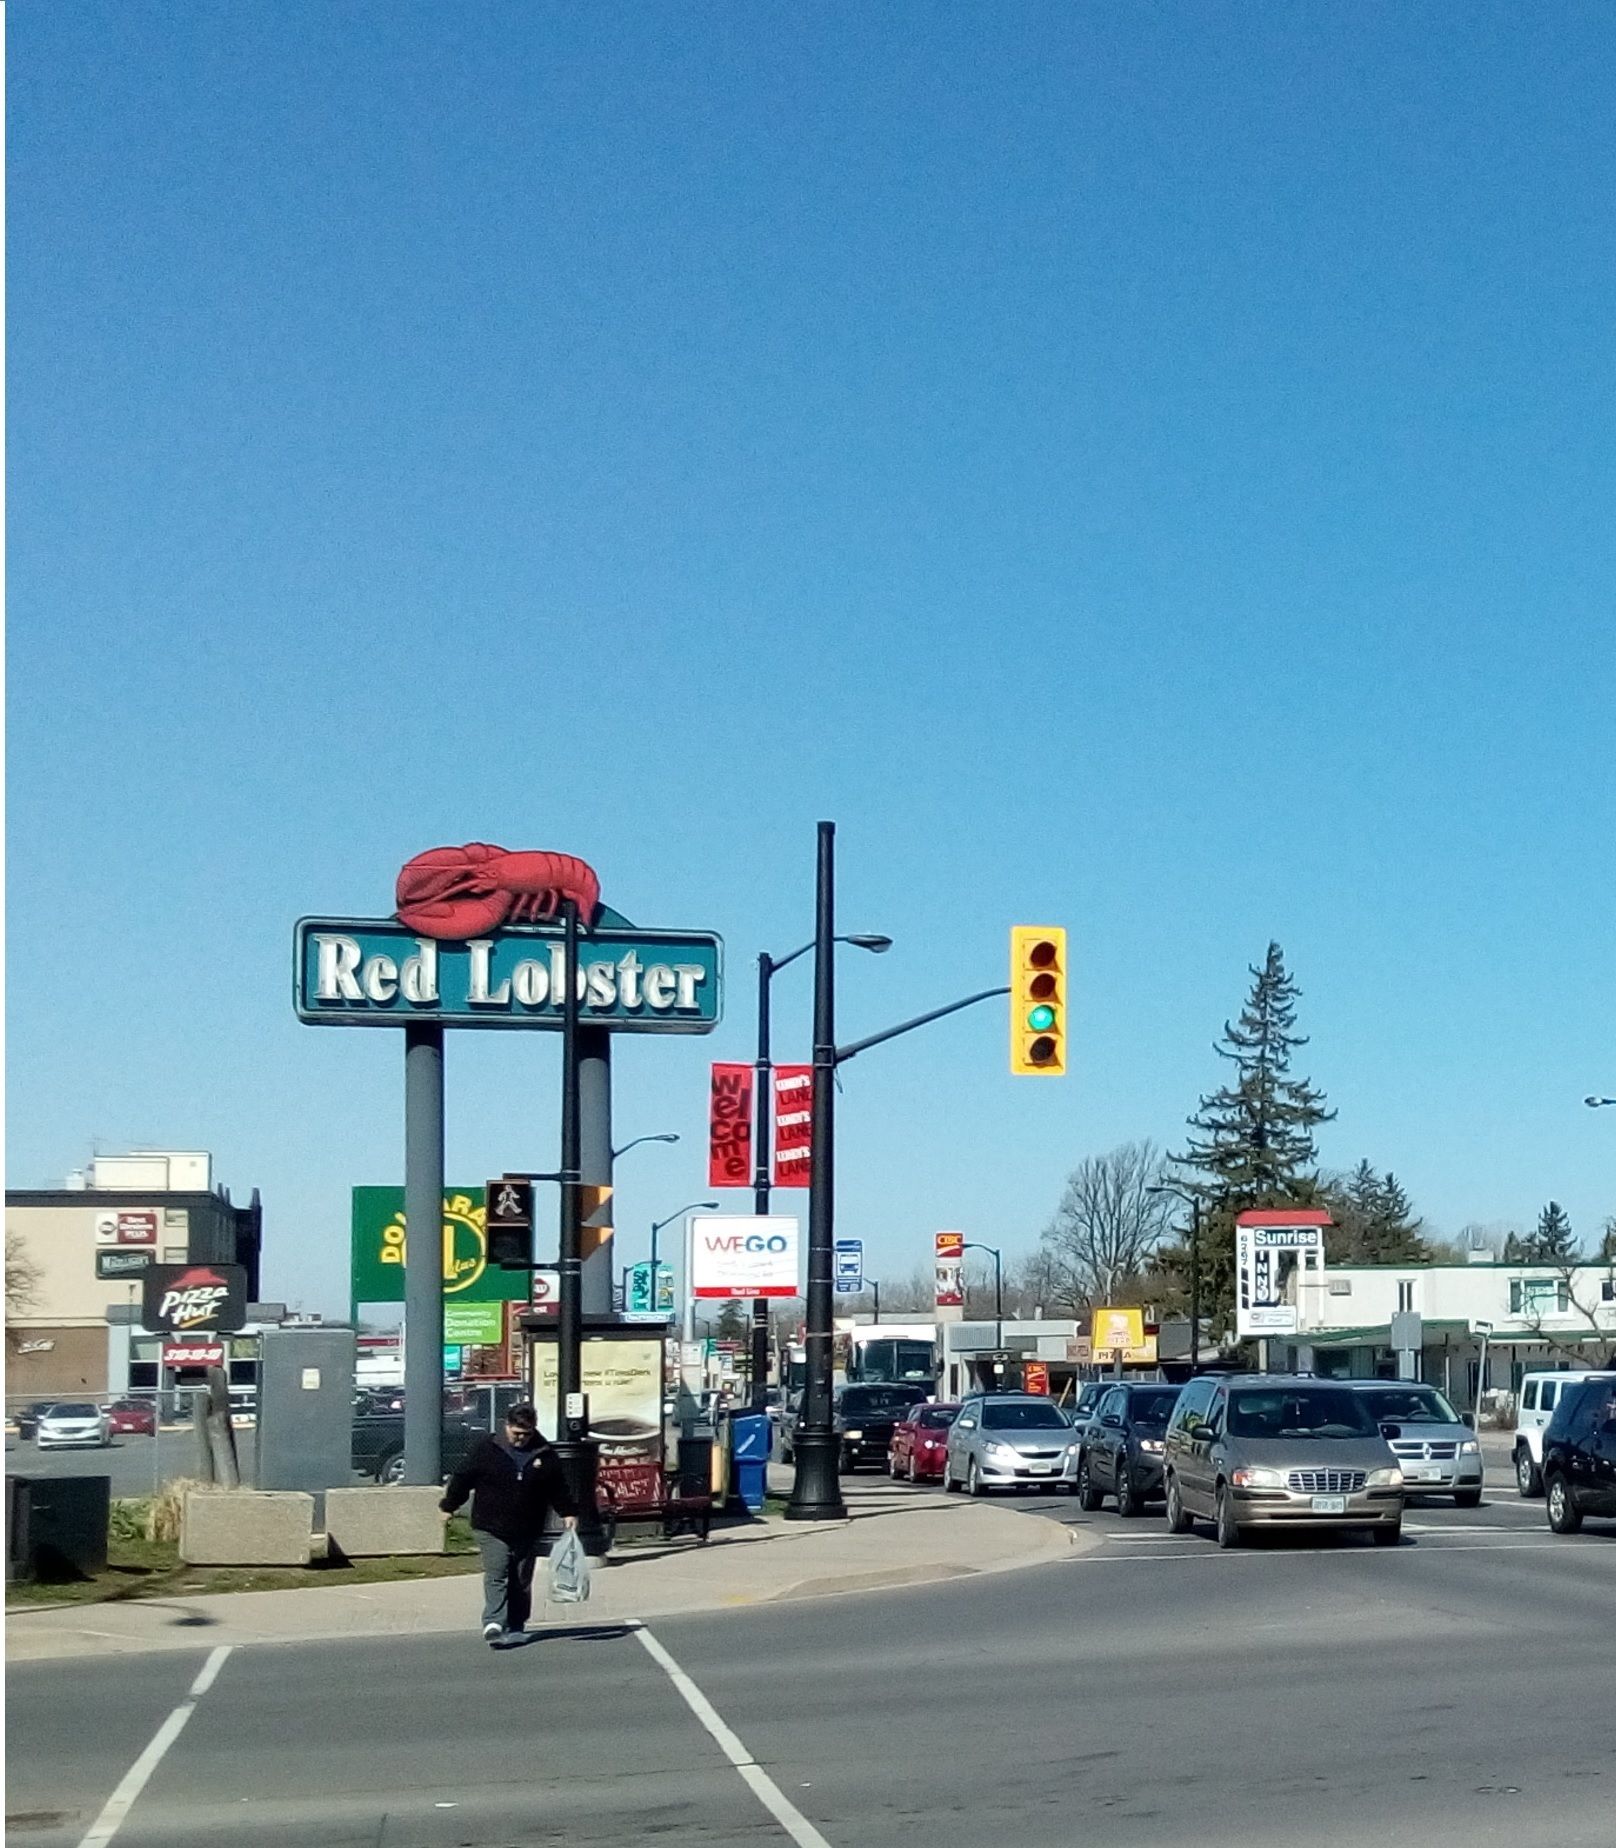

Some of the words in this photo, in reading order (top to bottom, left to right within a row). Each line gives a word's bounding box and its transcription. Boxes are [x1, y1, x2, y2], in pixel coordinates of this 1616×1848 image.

[312, 933, 440, 1003] Red
[465, 940, 706, 1009] Lobster
[705, 1235, 787, 1254] WEGO
[1255, 1230, 1317, 1244] Sunrise
[159, 1285, 229, 1318] Pizza
[170, 1300, 222, 1325] Hut
